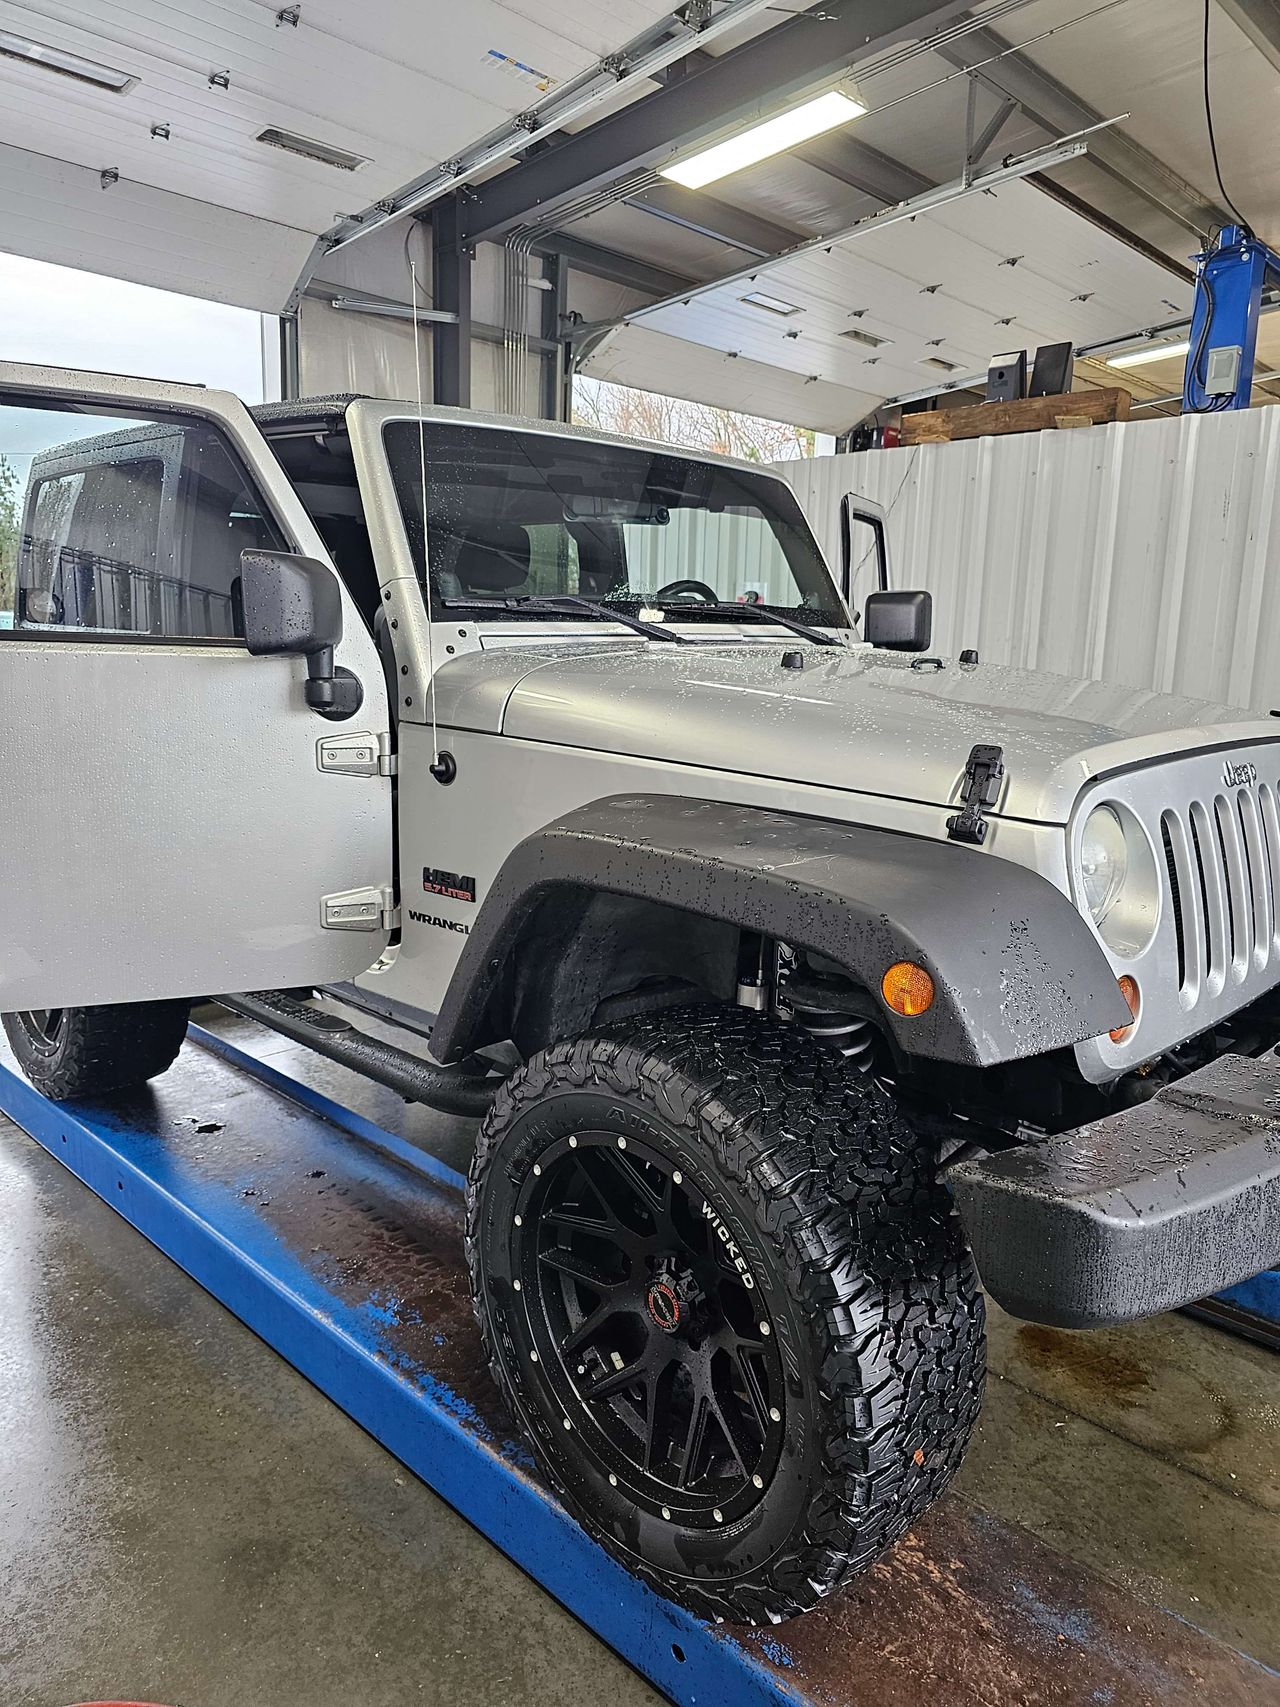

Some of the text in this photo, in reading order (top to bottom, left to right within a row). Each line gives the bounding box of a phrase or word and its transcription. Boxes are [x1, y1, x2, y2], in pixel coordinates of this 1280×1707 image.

[1221, 760, 1257, 788] Jeep
[423, 867, 476, 891] HEMI
[423, 881, 472, 901] 5.7 LITER
[408, 909, 470, 935] WRANGL
[702, 1200, 755, 1289] WICKED
